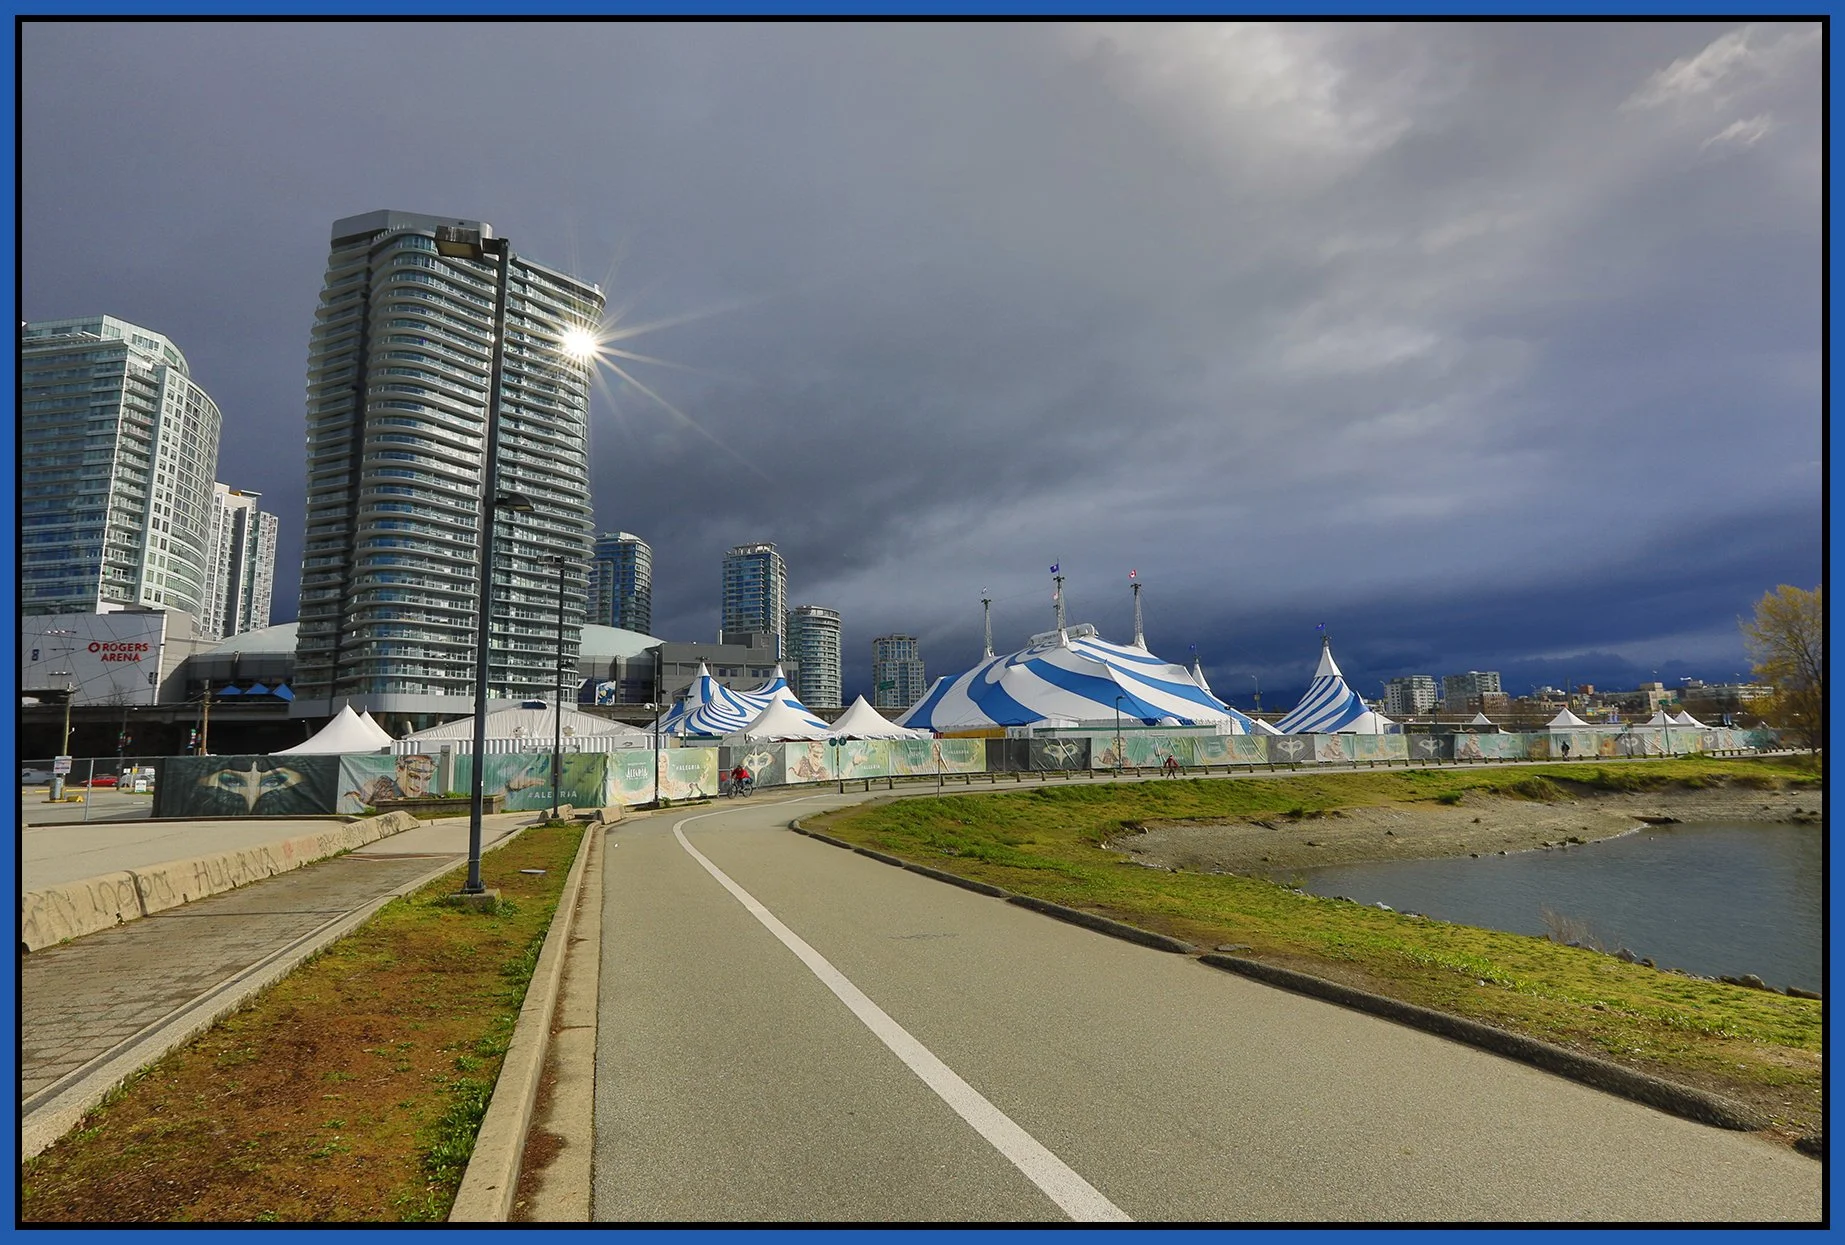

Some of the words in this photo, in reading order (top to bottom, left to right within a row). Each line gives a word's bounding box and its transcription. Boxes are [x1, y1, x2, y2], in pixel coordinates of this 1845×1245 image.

[102, 643, 149, 652] ROGERS
[101, 653, 142, 662] ARENA
[528, 790, 578, 799] #ALERIA
